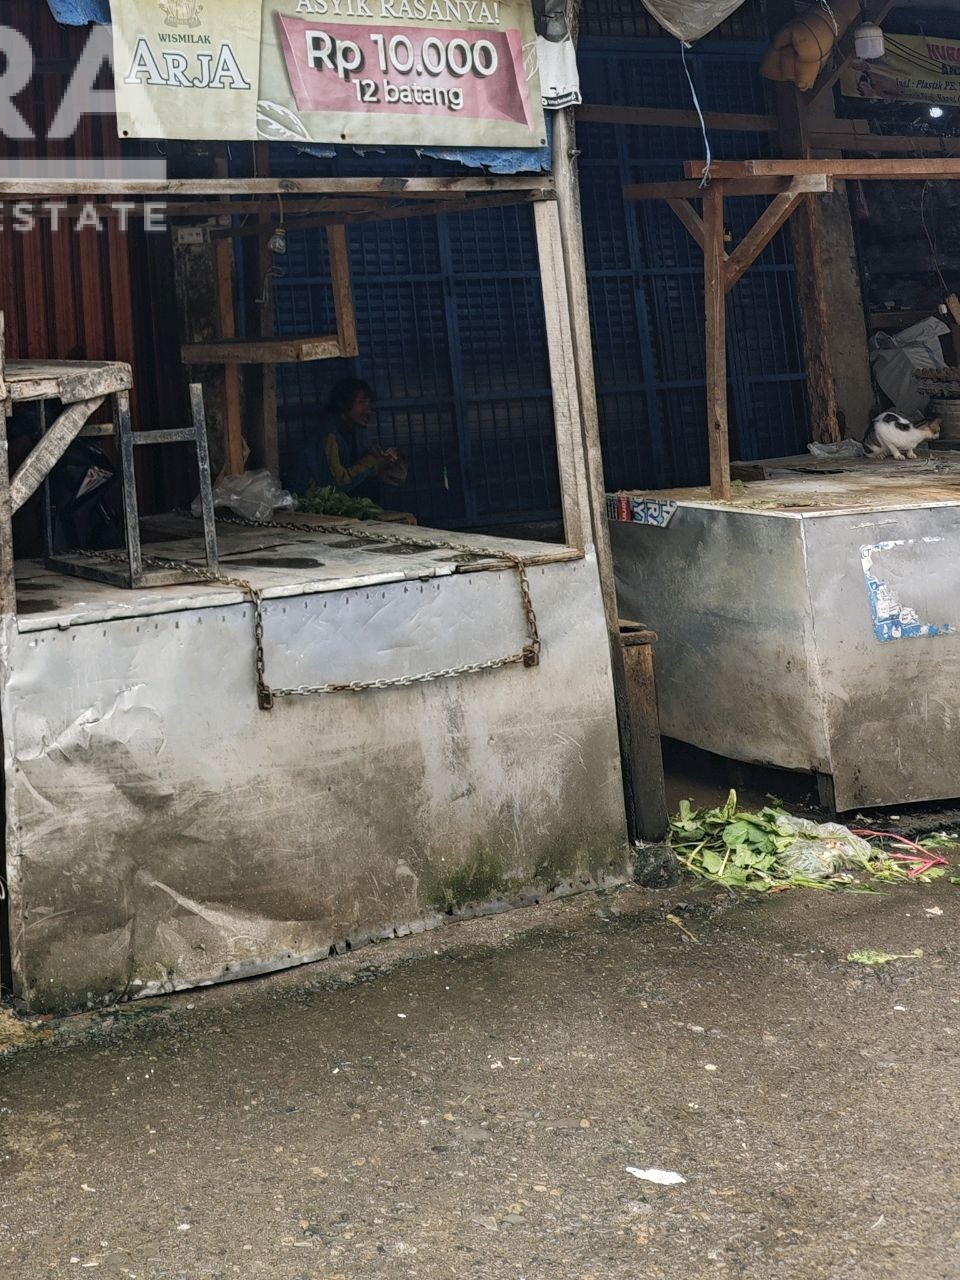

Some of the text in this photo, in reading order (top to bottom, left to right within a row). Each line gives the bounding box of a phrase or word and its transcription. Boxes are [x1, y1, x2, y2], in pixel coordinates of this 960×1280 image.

[158, 33, 211, 45] WISMILAK
[124, 38, 251, 90] ARJA
[305, 30, 500, 80] Rp 10.000
[352, 79, 464, 110] 12 batang
[916, 79, 944, 90] Plastik
